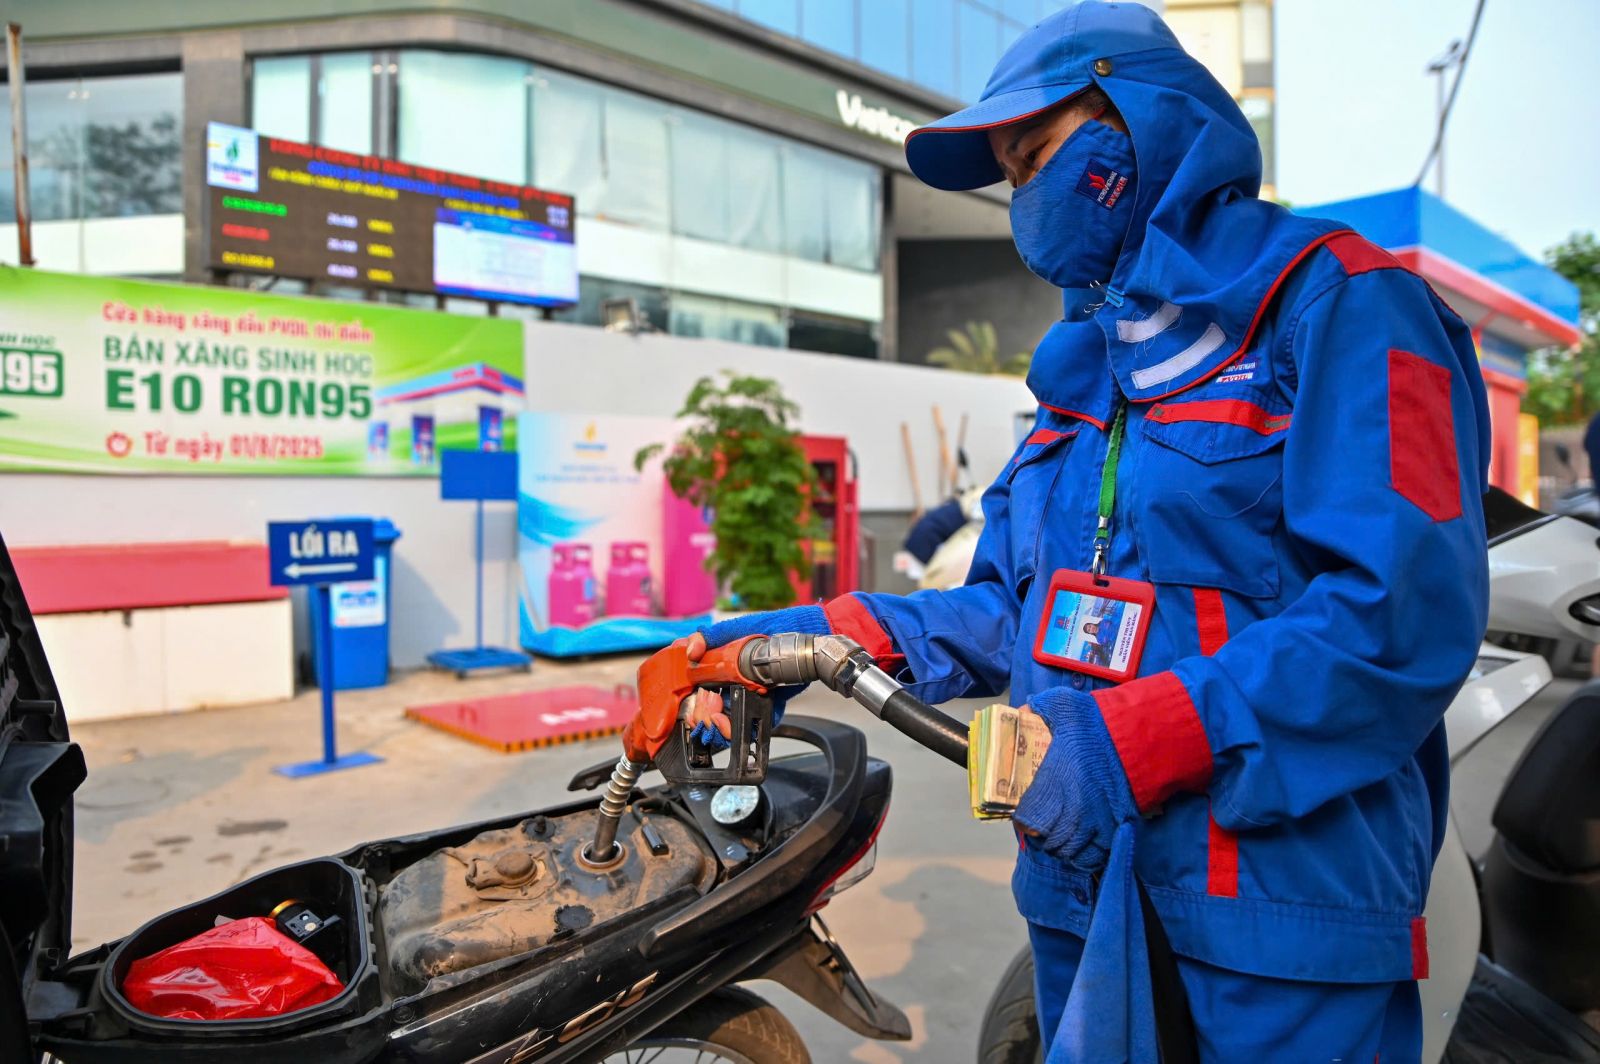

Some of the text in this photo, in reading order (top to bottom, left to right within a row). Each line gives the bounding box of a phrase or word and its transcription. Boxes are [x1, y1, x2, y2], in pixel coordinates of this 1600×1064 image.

[102, 300, 138, 324] Cửa
[143, 305, 186, 332] hàng
[192, 310, 231, 336] xăng
[0, 349, 59, 395] 95
[105, 331, 372, 377] BÁN XĂNG SINH HỌC
[106, 368, 372, 421] E10 RON95
[144, 428, 170, 455] Từ
[175, 431, 223, 462] ngày
[289, 523, 360, 559] LỐI RA
